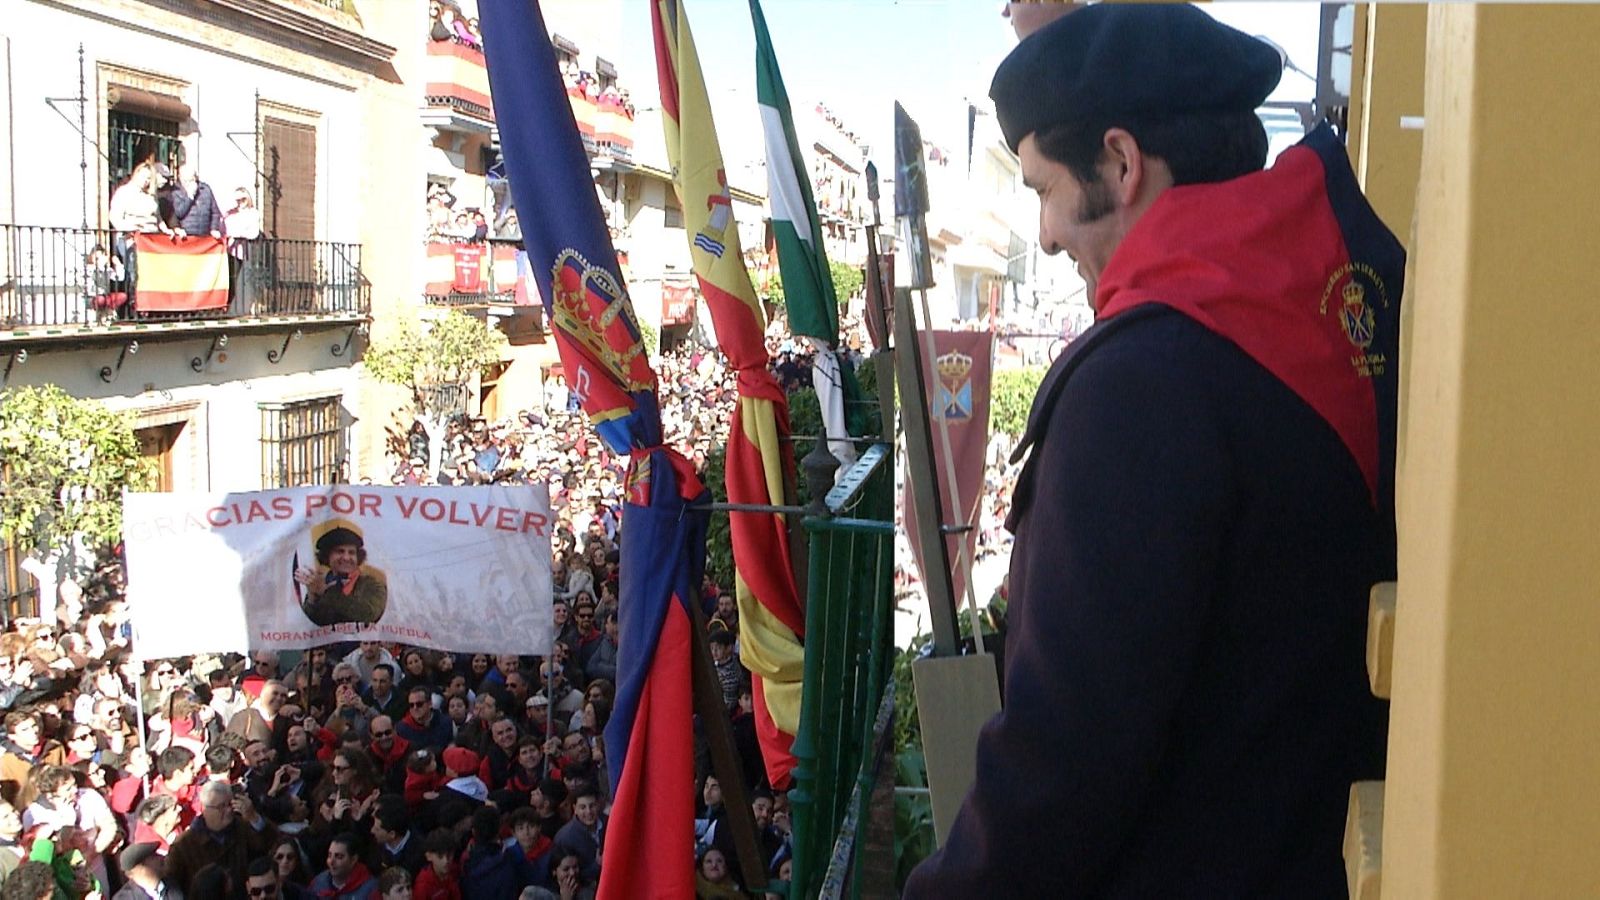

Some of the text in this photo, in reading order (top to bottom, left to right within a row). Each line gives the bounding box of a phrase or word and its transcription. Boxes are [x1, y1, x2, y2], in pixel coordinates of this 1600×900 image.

[305, 492, 382, 518] POR
[395, 495, 548, 537] VOLVER
[261, 622, 432, 641] MORANTE DE LA PUEBLA
